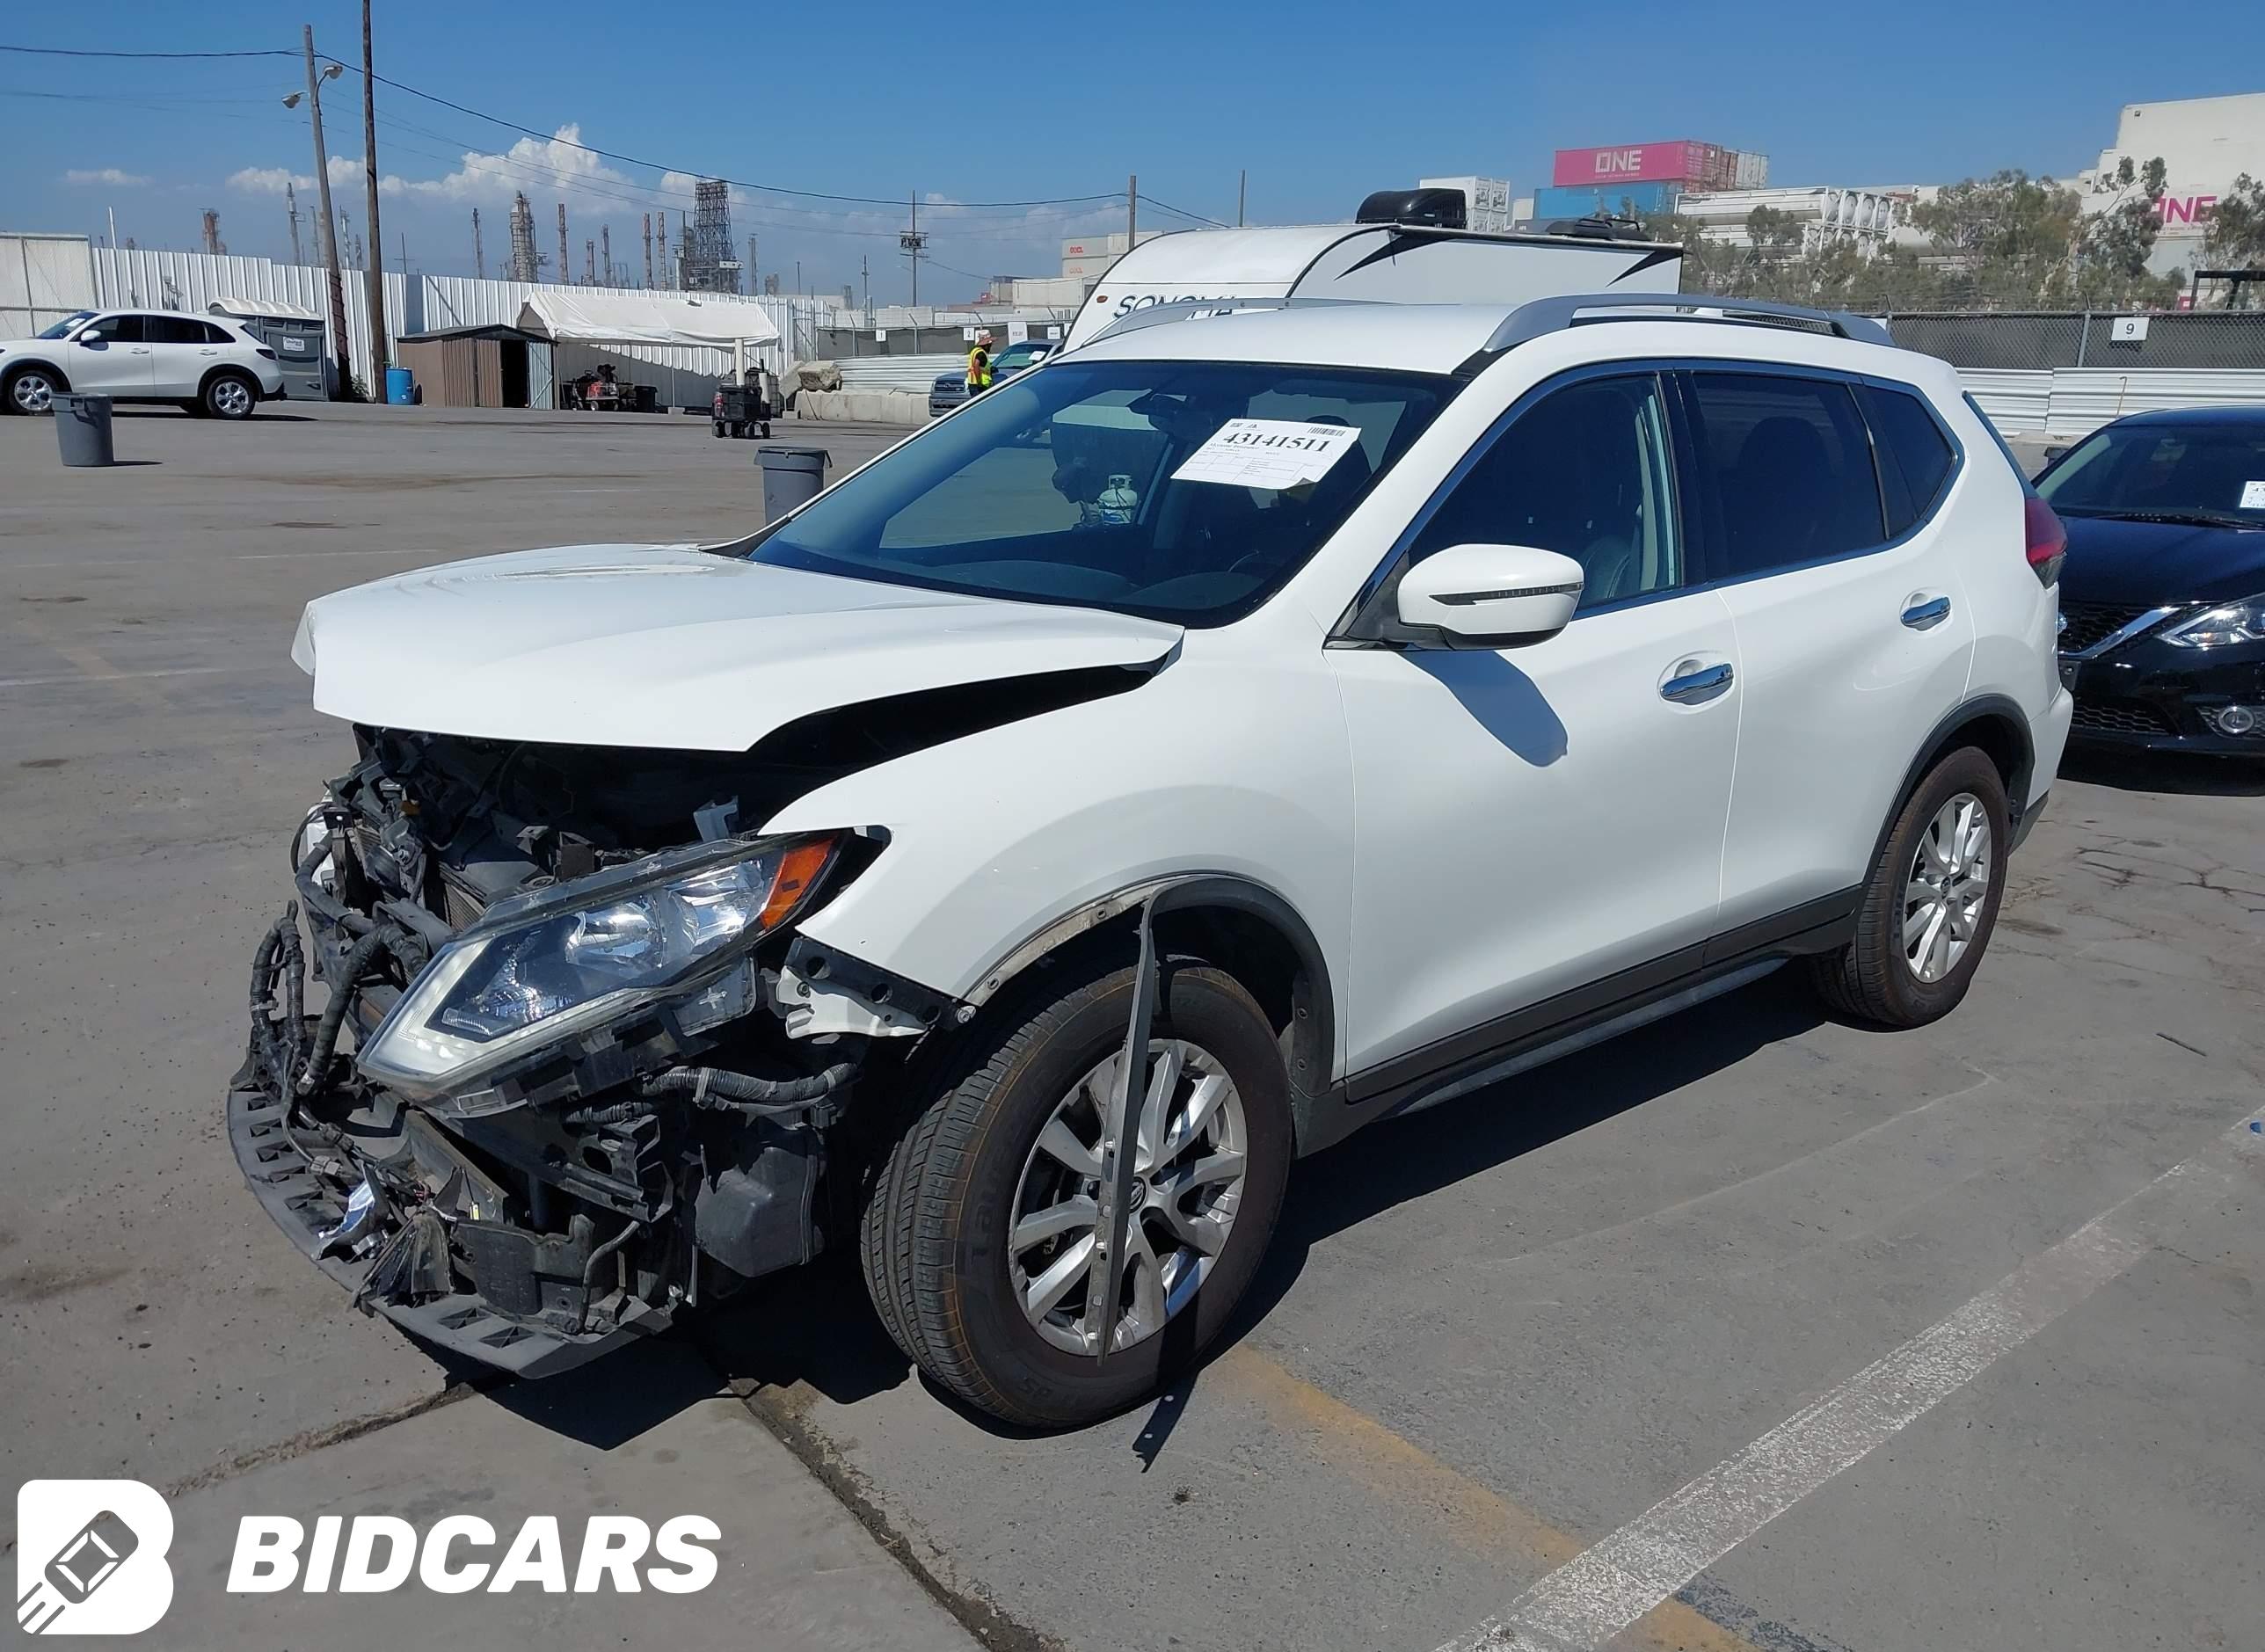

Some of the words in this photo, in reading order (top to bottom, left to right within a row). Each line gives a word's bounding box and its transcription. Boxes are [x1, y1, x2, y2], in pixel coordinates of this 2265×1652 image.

[1595, 149, 1642, 172] ONE
[2125, 323, 2135, 335] 9
[1223, 432, 1331, 452] 43141511
